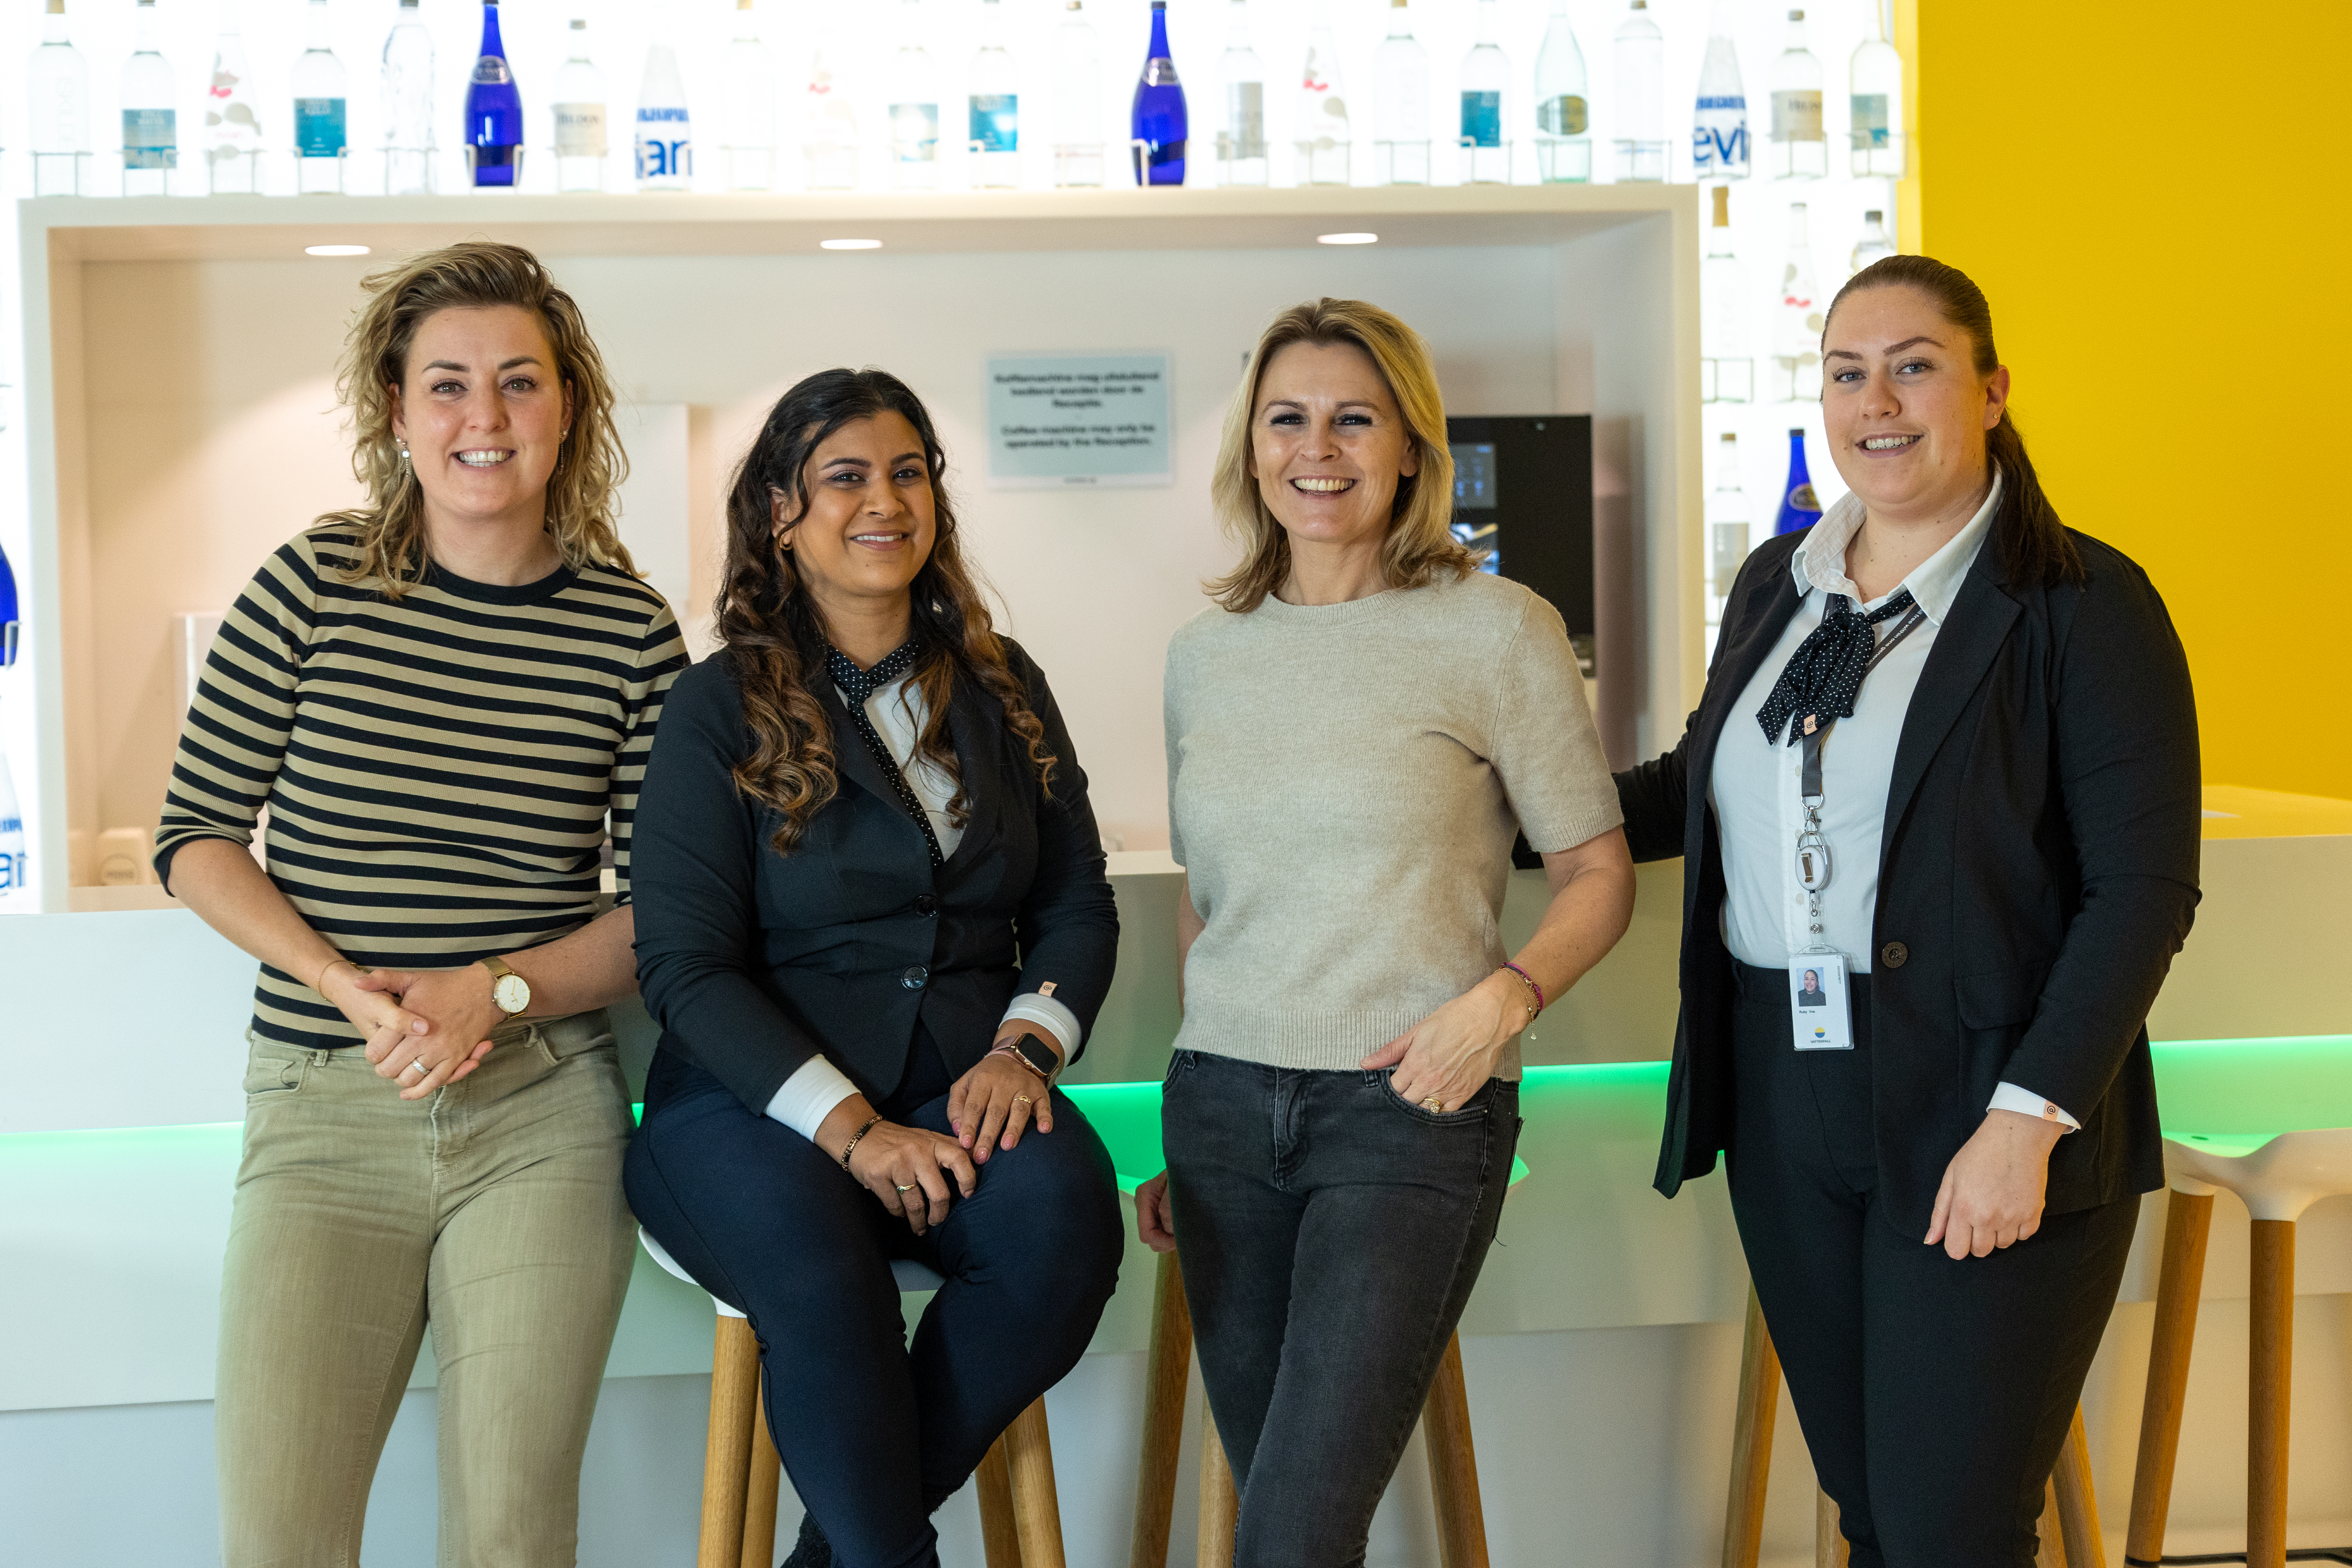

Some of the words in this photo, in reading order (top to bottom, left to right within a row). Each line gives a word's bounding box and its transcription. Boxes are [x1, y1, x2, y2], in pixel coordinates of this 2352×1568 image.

[1908, 614, 1919, 624] free
[1894, 624, 1910, 638] within
[1885, 638, 1895, 647] one
